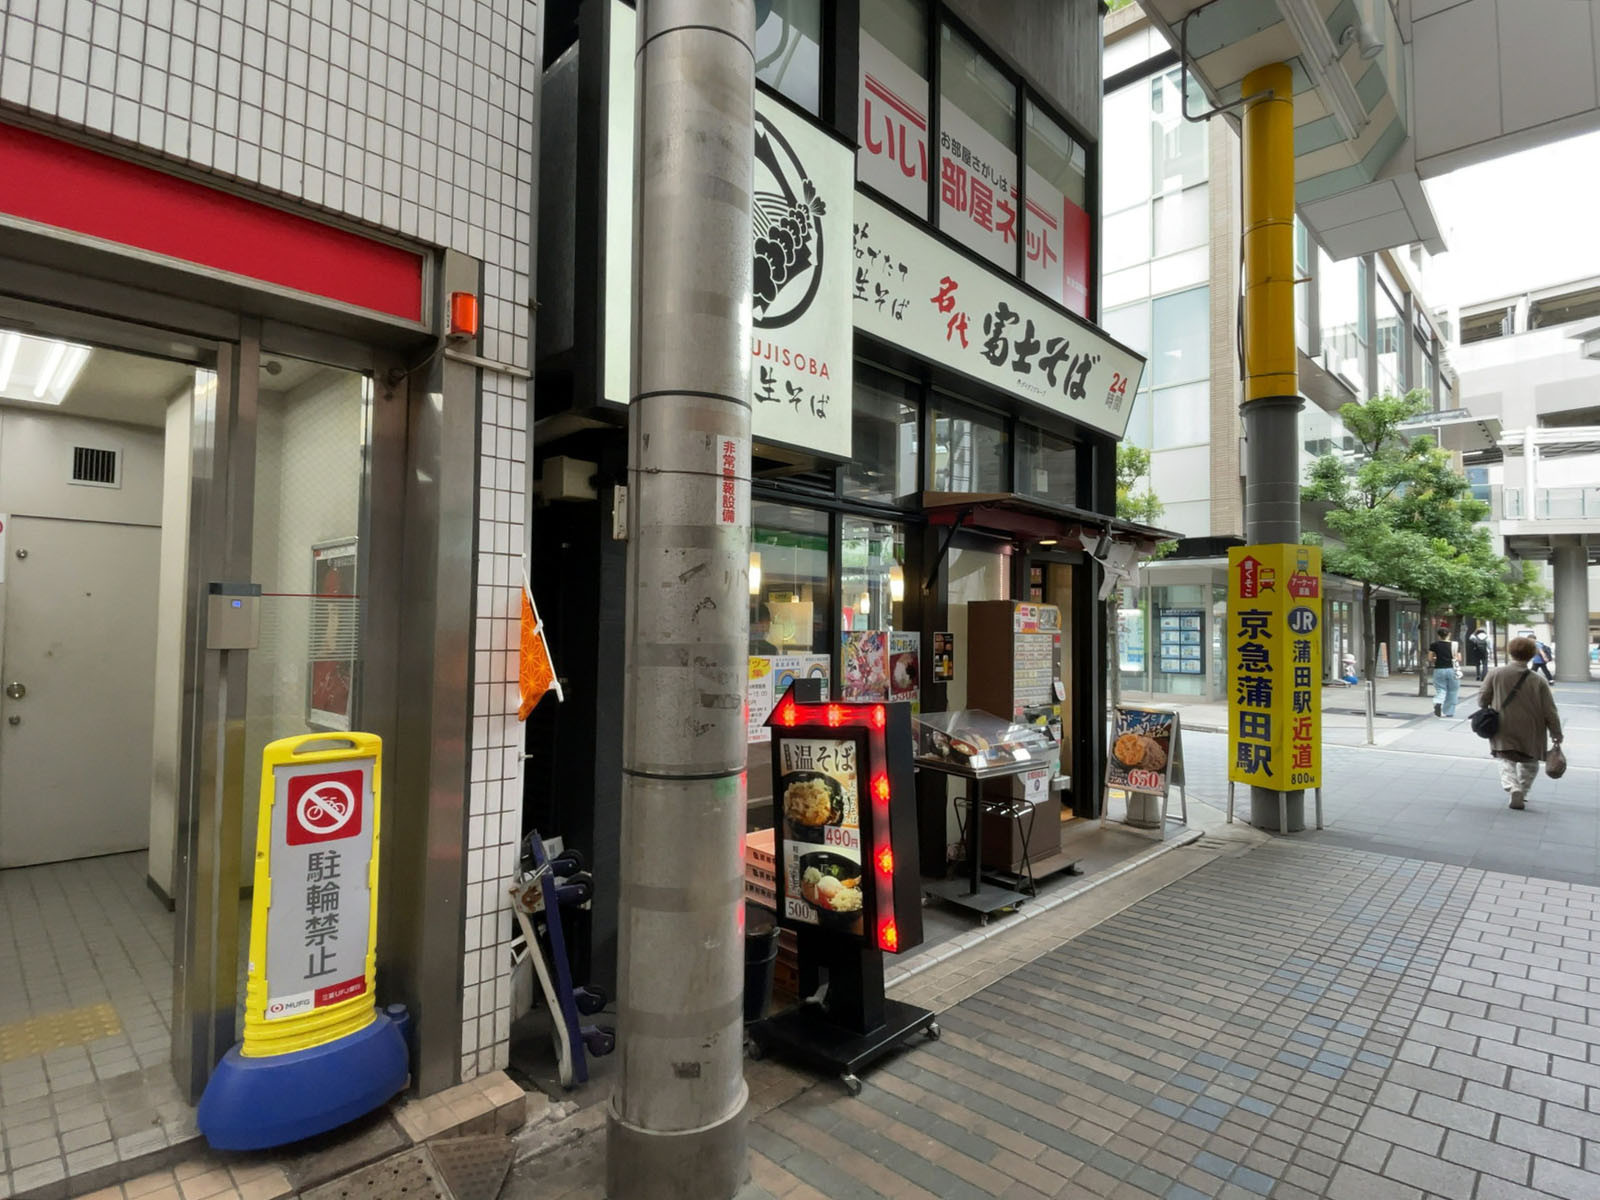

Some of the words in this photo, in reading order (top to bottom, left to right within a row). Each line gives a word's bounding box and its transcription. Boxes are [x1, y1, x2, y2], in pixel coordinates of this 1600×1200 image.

[940, 131, 1009, 192] お部屋さがしは
[853, 267, 910, 320] 生そば
[979, 301, 1101, 400] 富士そば
[754, 365, 830, 419] 生そば
[1108, 372, 1128, 394] 24
[722, 440, 736, 524] 非常警報設備
[1292, 611, 1314, 631] JR
[1237, 608, 1274, 778] 京急蒲田駅
[794, 744, 854, 772] 温そば
[825, 828, 859, 848] 490円
[304, 850, 341, 979] 駐輪禁止
[285, 998, 311, 1010] MUFG
